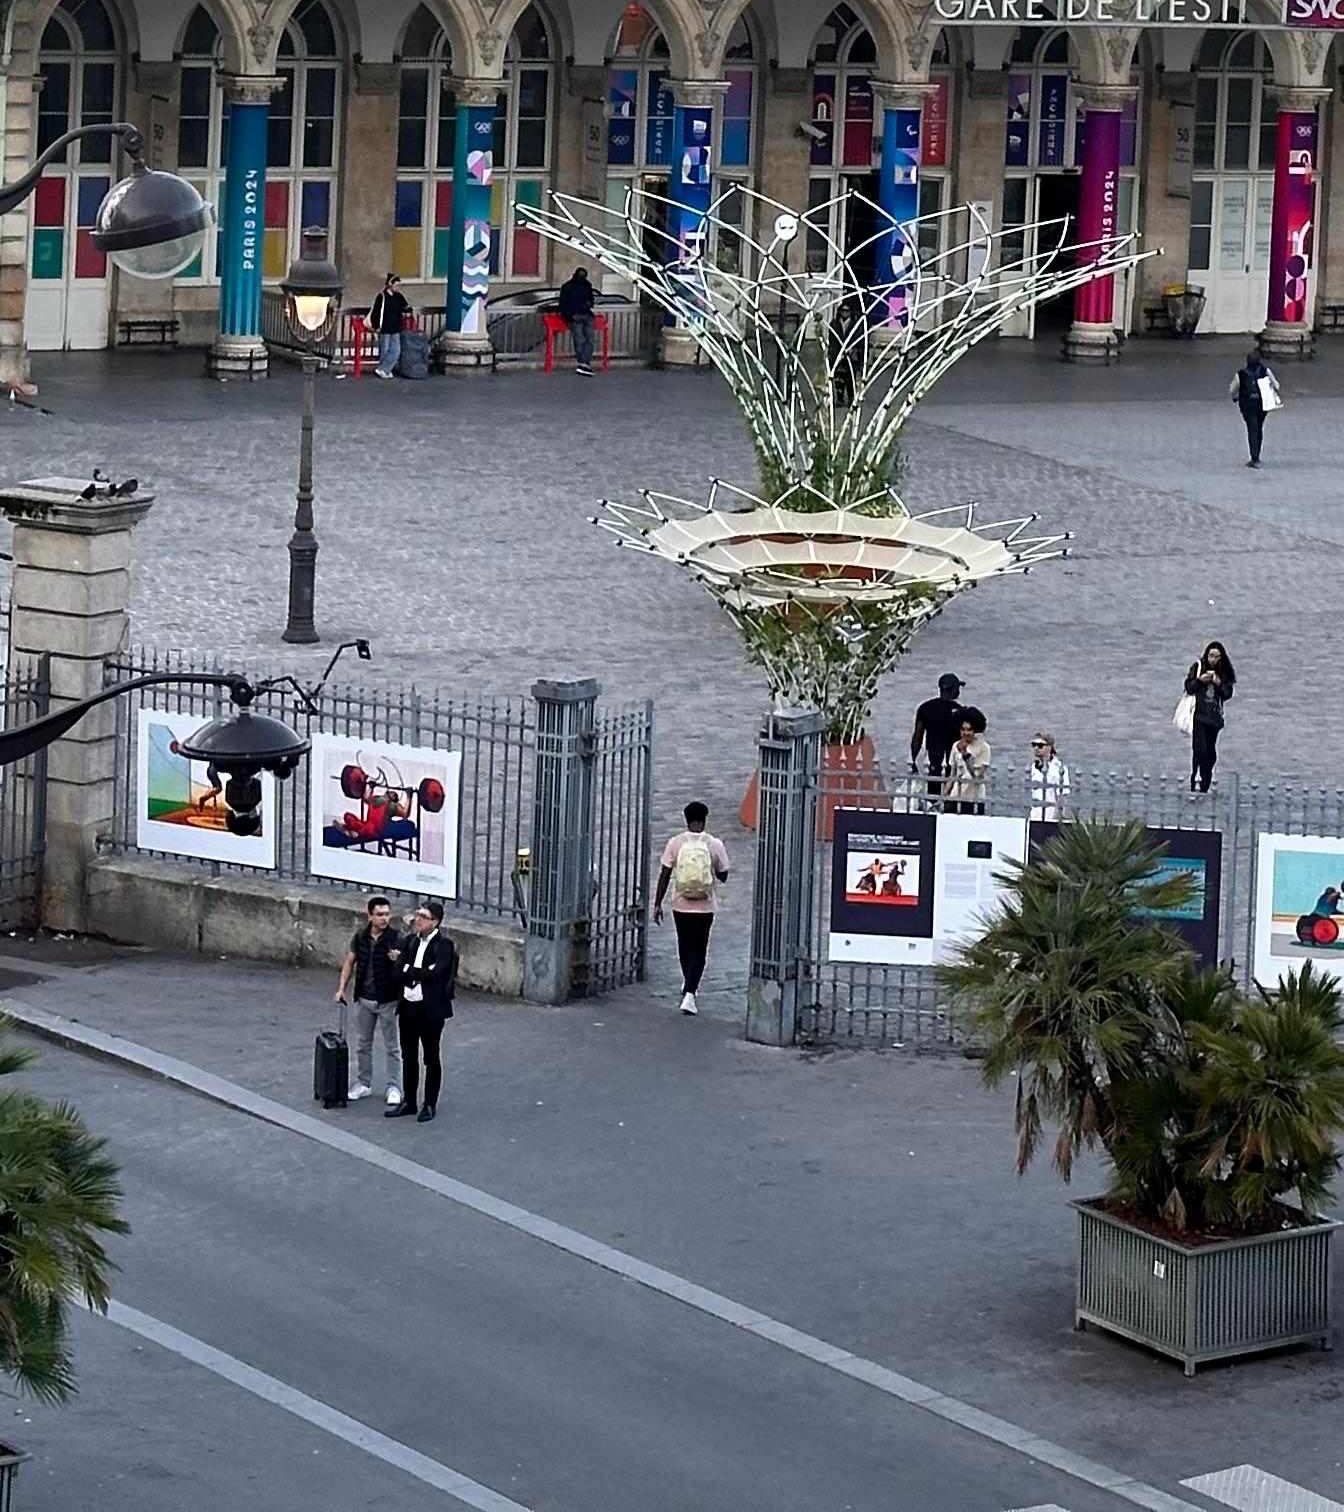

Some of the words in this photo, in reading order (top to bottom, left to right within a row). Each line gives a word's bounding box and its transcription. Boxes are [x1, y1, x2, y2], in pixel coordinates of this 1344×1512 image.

[244, 169, 258, 215] 2024
[1103, 171, 1115, 213] 2024
[243, 219, 256, 270] PARIS
